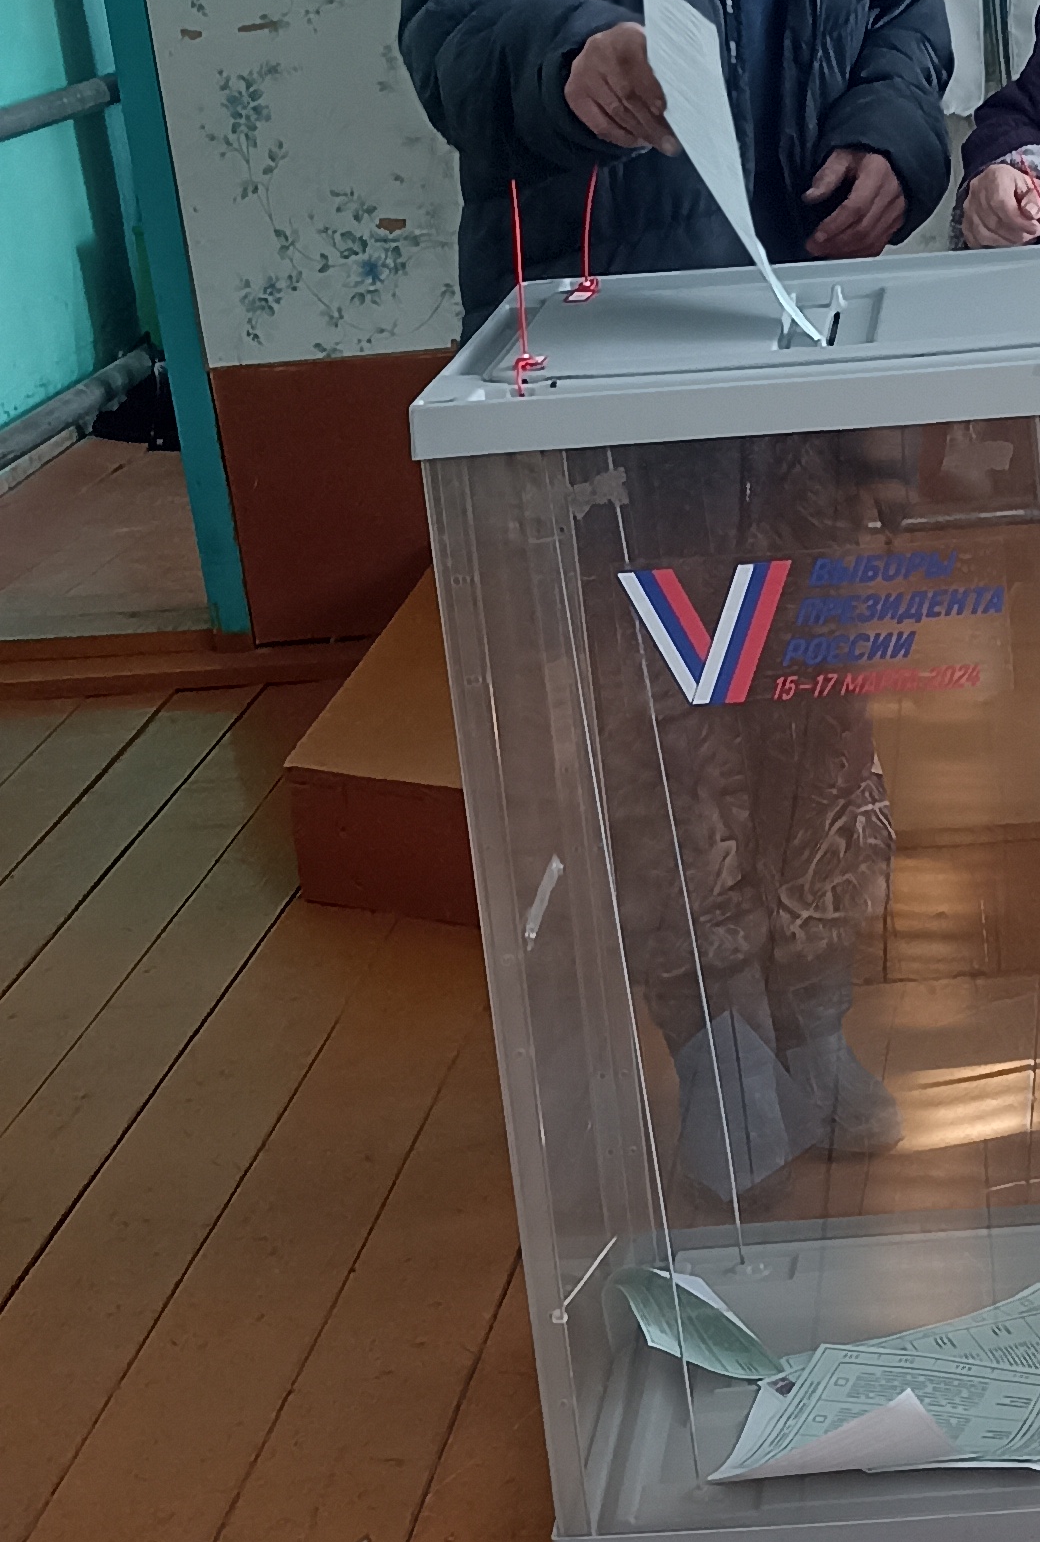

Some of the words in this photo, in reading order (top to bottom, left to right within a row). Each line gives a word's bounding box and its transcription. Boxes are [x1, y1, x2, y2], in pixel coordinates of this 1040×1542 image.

[808, 551, 957, 587] ВЫБОРЫ
[796, 585, 1005, 626] ПРЕЗИДЕНТА
[782, 630, 917, 667] РОССИИ
